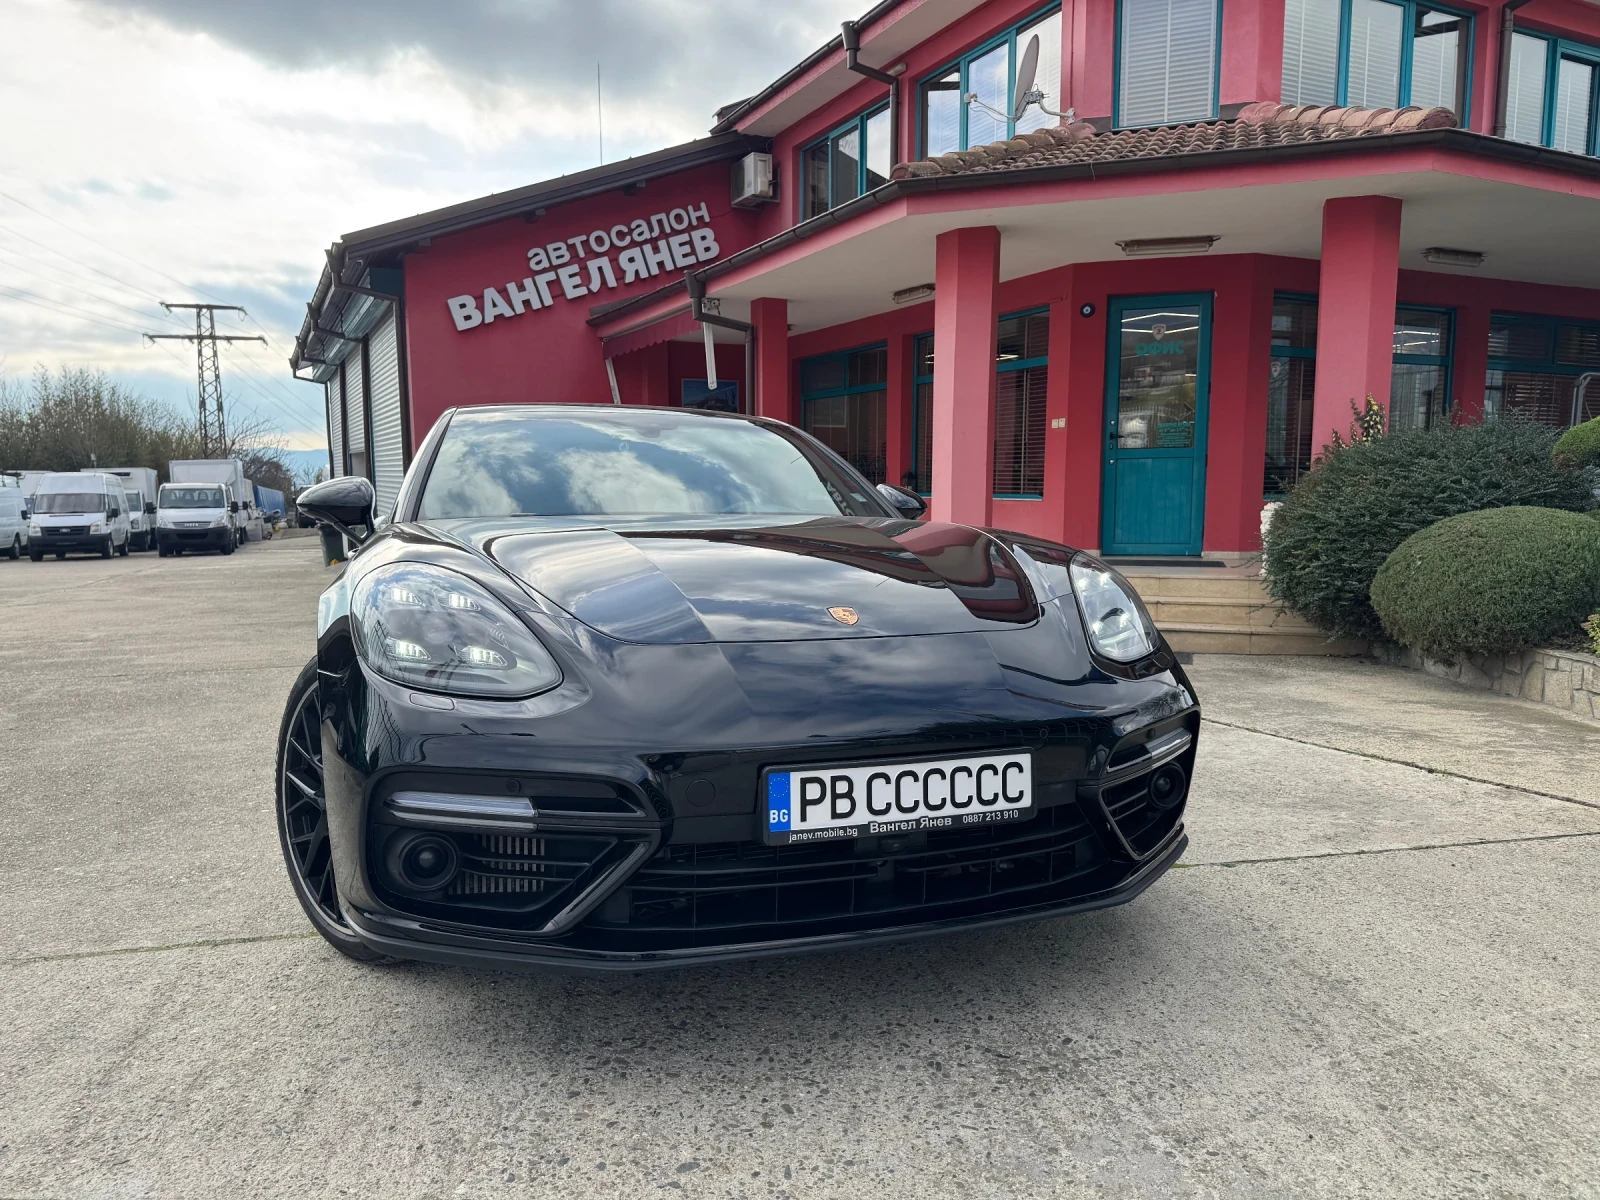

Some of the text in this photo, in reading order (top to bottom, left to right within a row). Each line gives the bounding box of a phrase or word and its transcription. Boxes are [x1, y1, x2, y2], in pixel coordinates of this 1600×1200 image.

[527, 201, 711, 271] автосалон
[446, 227, 720, 332] ВАНГЕЛ ЯНЕВ
[1136, 341, 1184, 357] ОФИС
[799, 761, 1024, 823] PB CCCCCC
[769, 809, 789, 824] BG
[788, 809, 1019, 843] janev.mobile.bg Вангел Янев 0887 213 910
